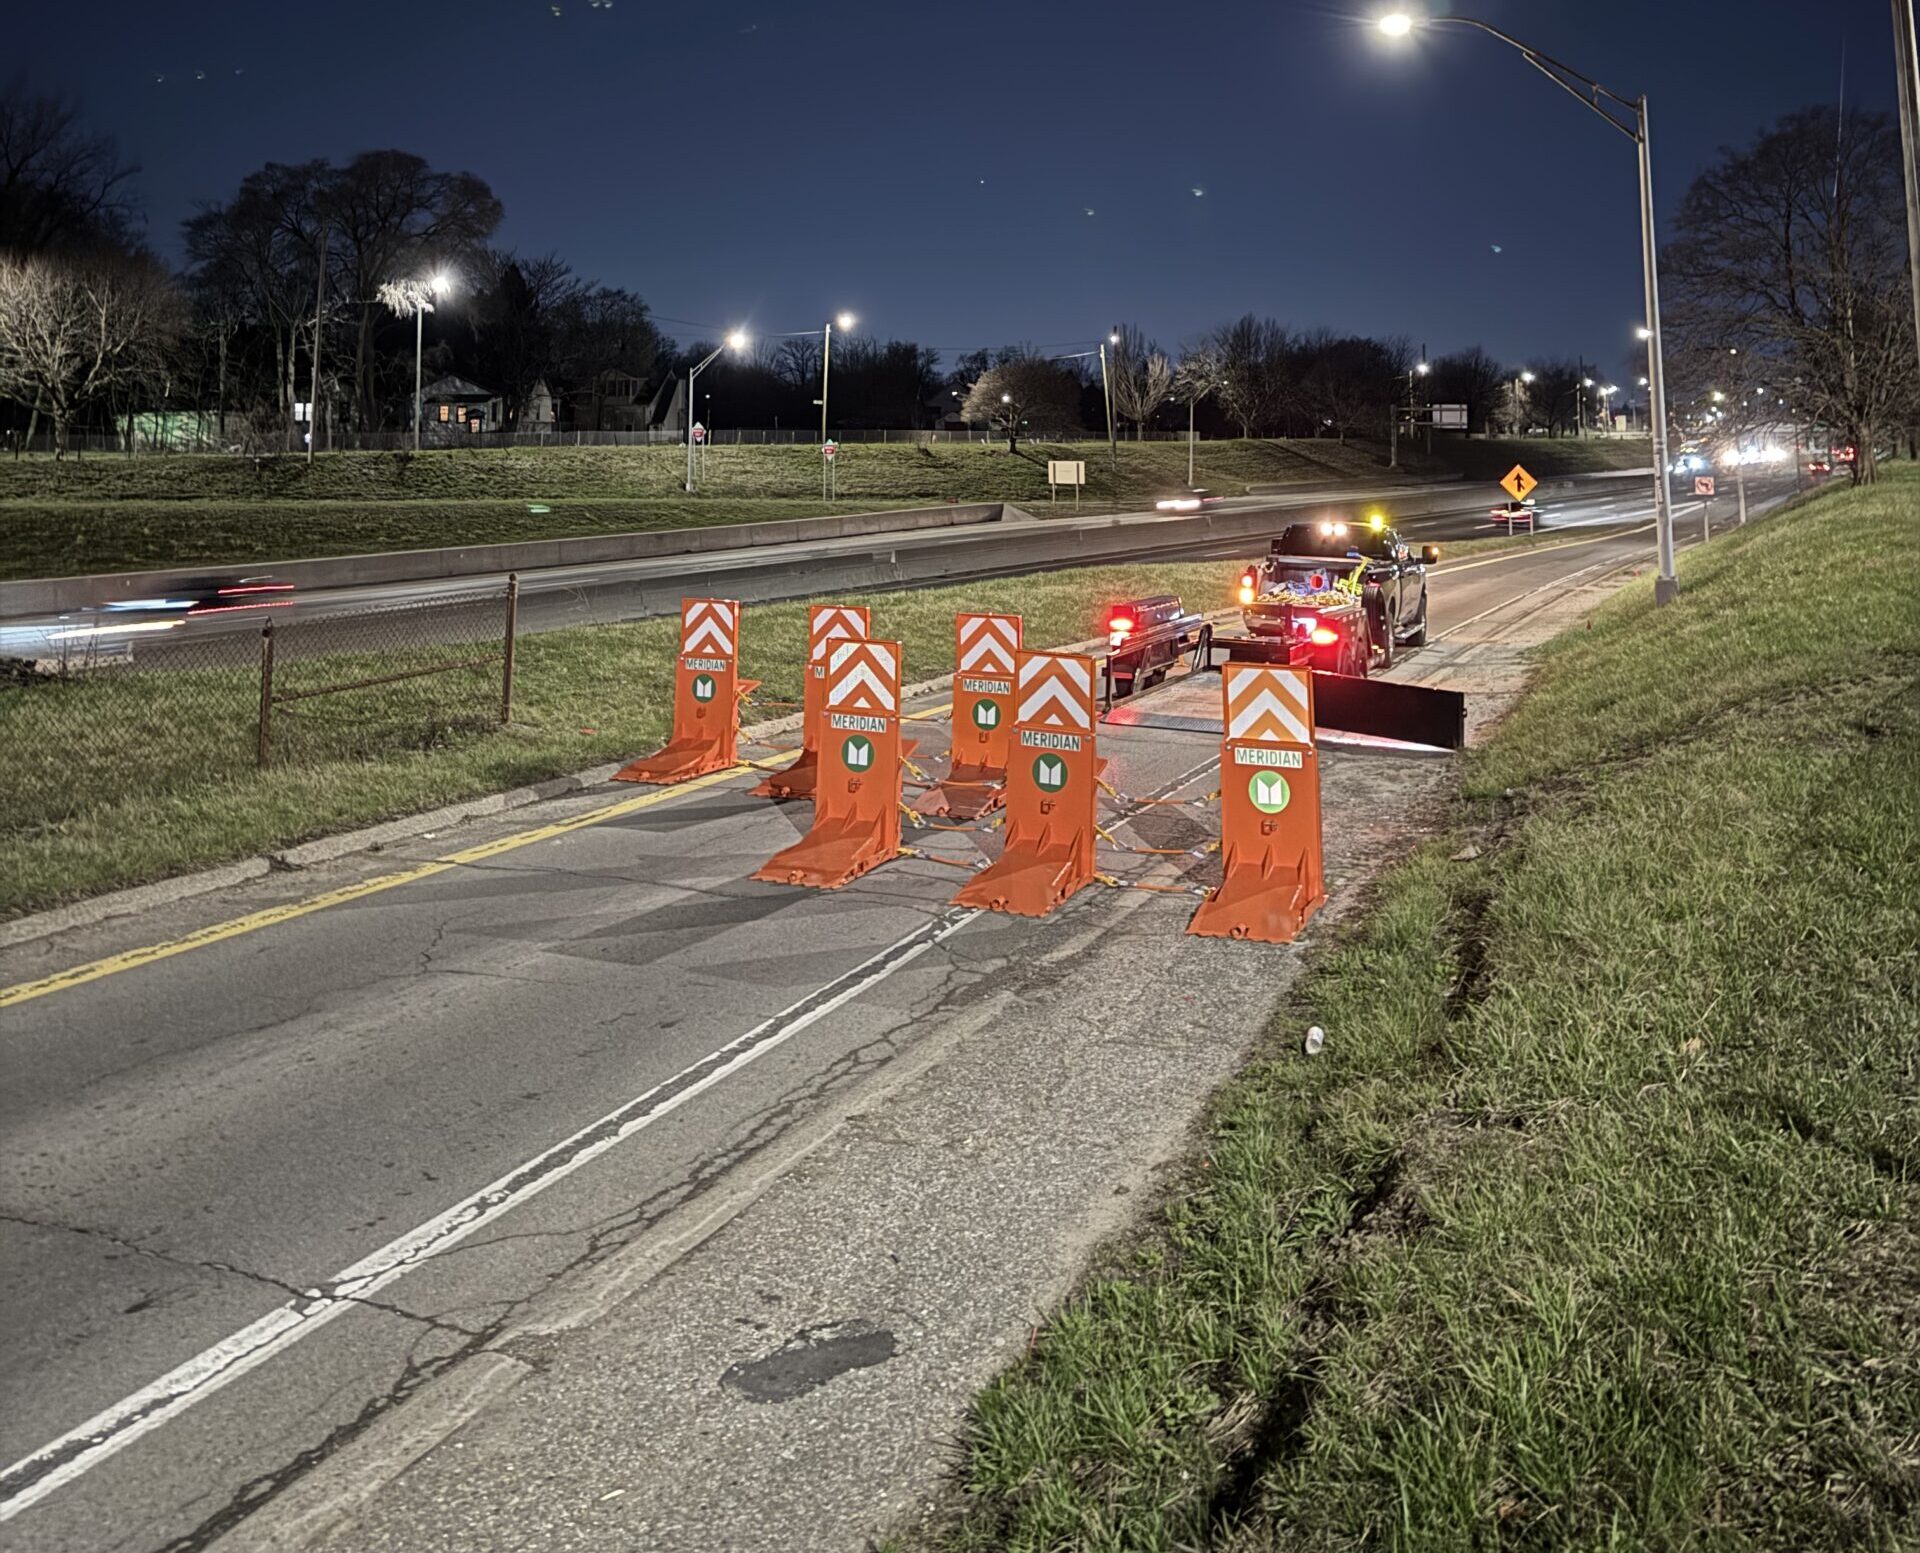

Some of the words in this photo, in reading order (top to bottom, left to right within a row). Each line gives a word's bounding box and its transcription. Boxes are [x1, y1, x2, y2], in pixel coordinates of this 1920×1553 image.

[686, 659, 725, 671] MERIDIAN
[964, 680, 1010, 693] MERIDIAN
[832, 715, 886, 732] MERIDIAN
[1022, 731, 1080, 750] MERIDIAN
[1236, 749, 1301, 767] MERIDIAN
